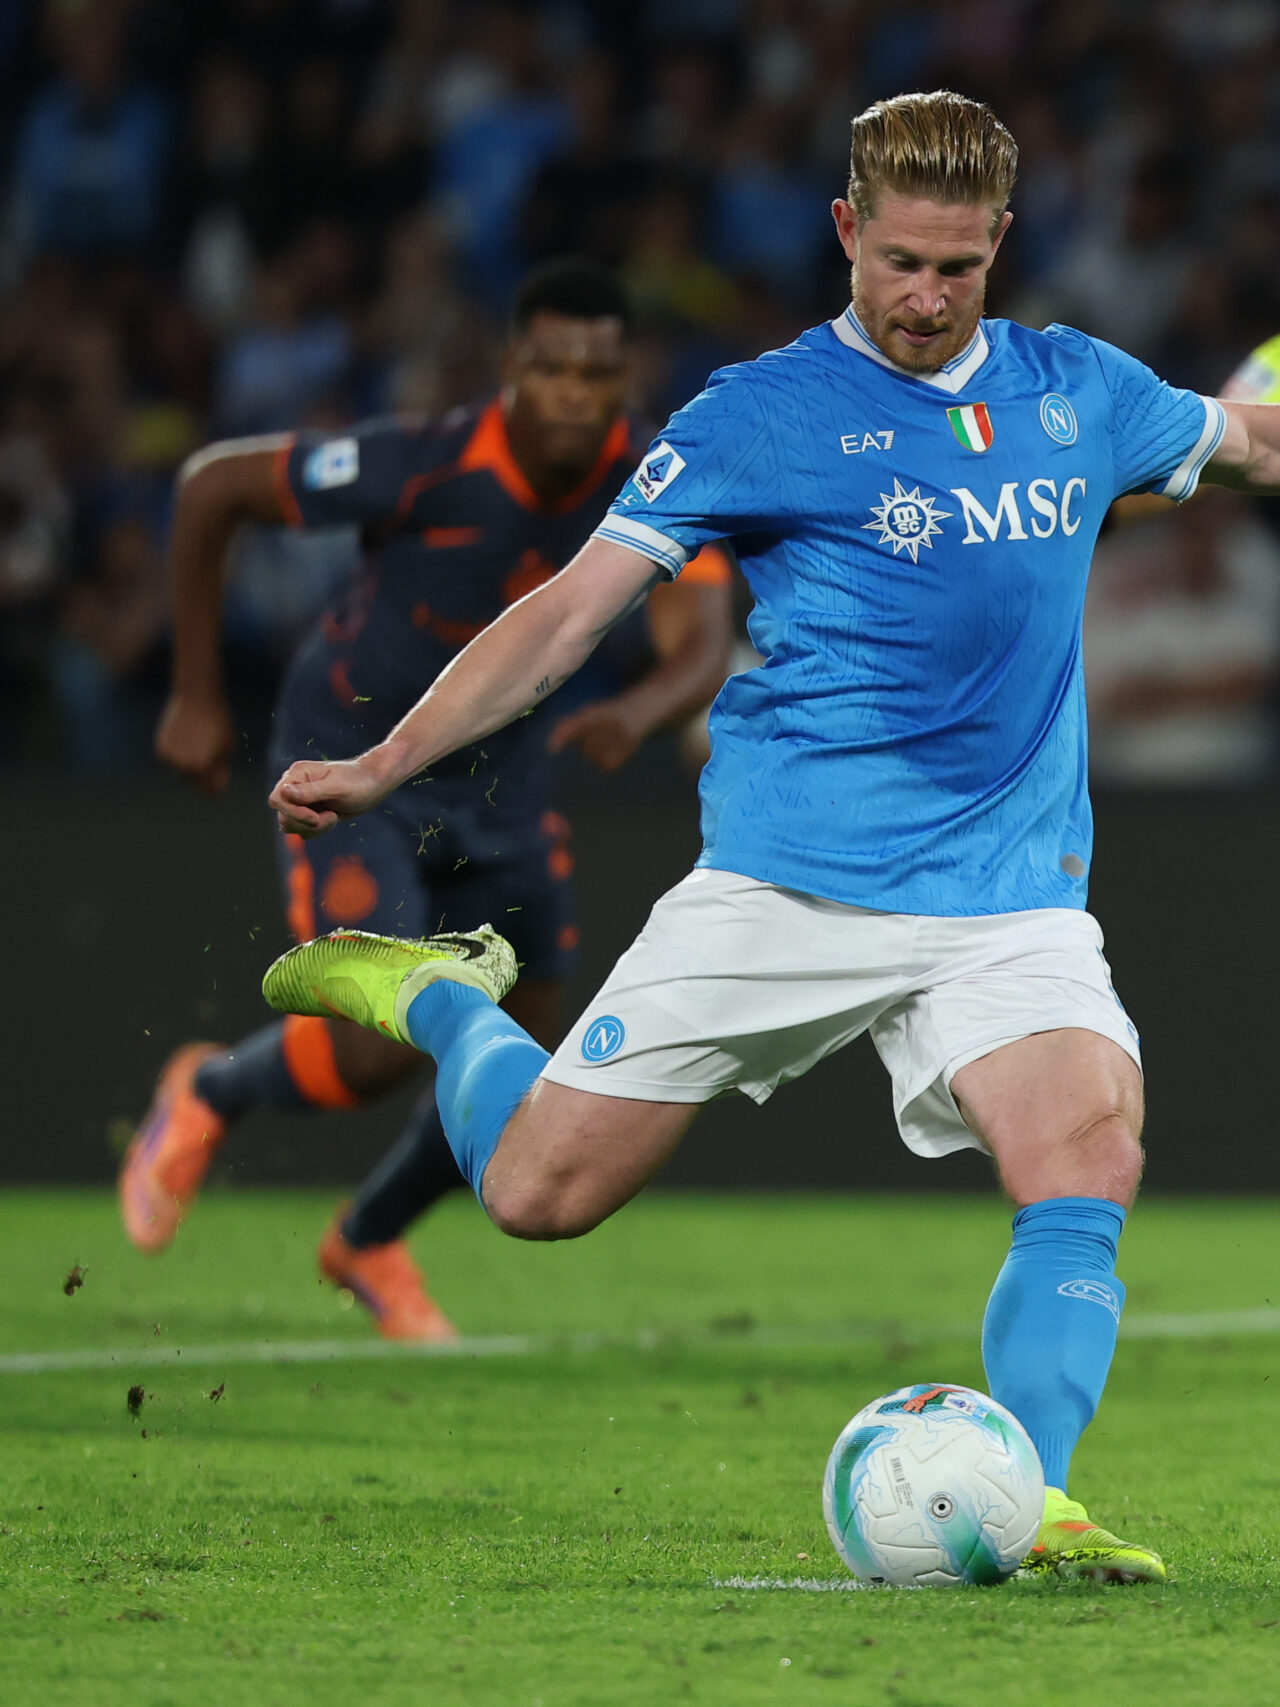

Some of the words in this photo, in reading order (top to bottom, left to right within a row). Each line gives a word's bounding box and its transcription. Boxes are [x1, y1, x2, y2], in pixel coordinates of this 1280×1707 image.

[1048, 407, 1068, 431] N
[840, 430, 895, 454] EA7
[639, 474, 652, 490] SERIE
[950, 477, 1087, 544] MSC
[589, 1026, 616, 1053] N
